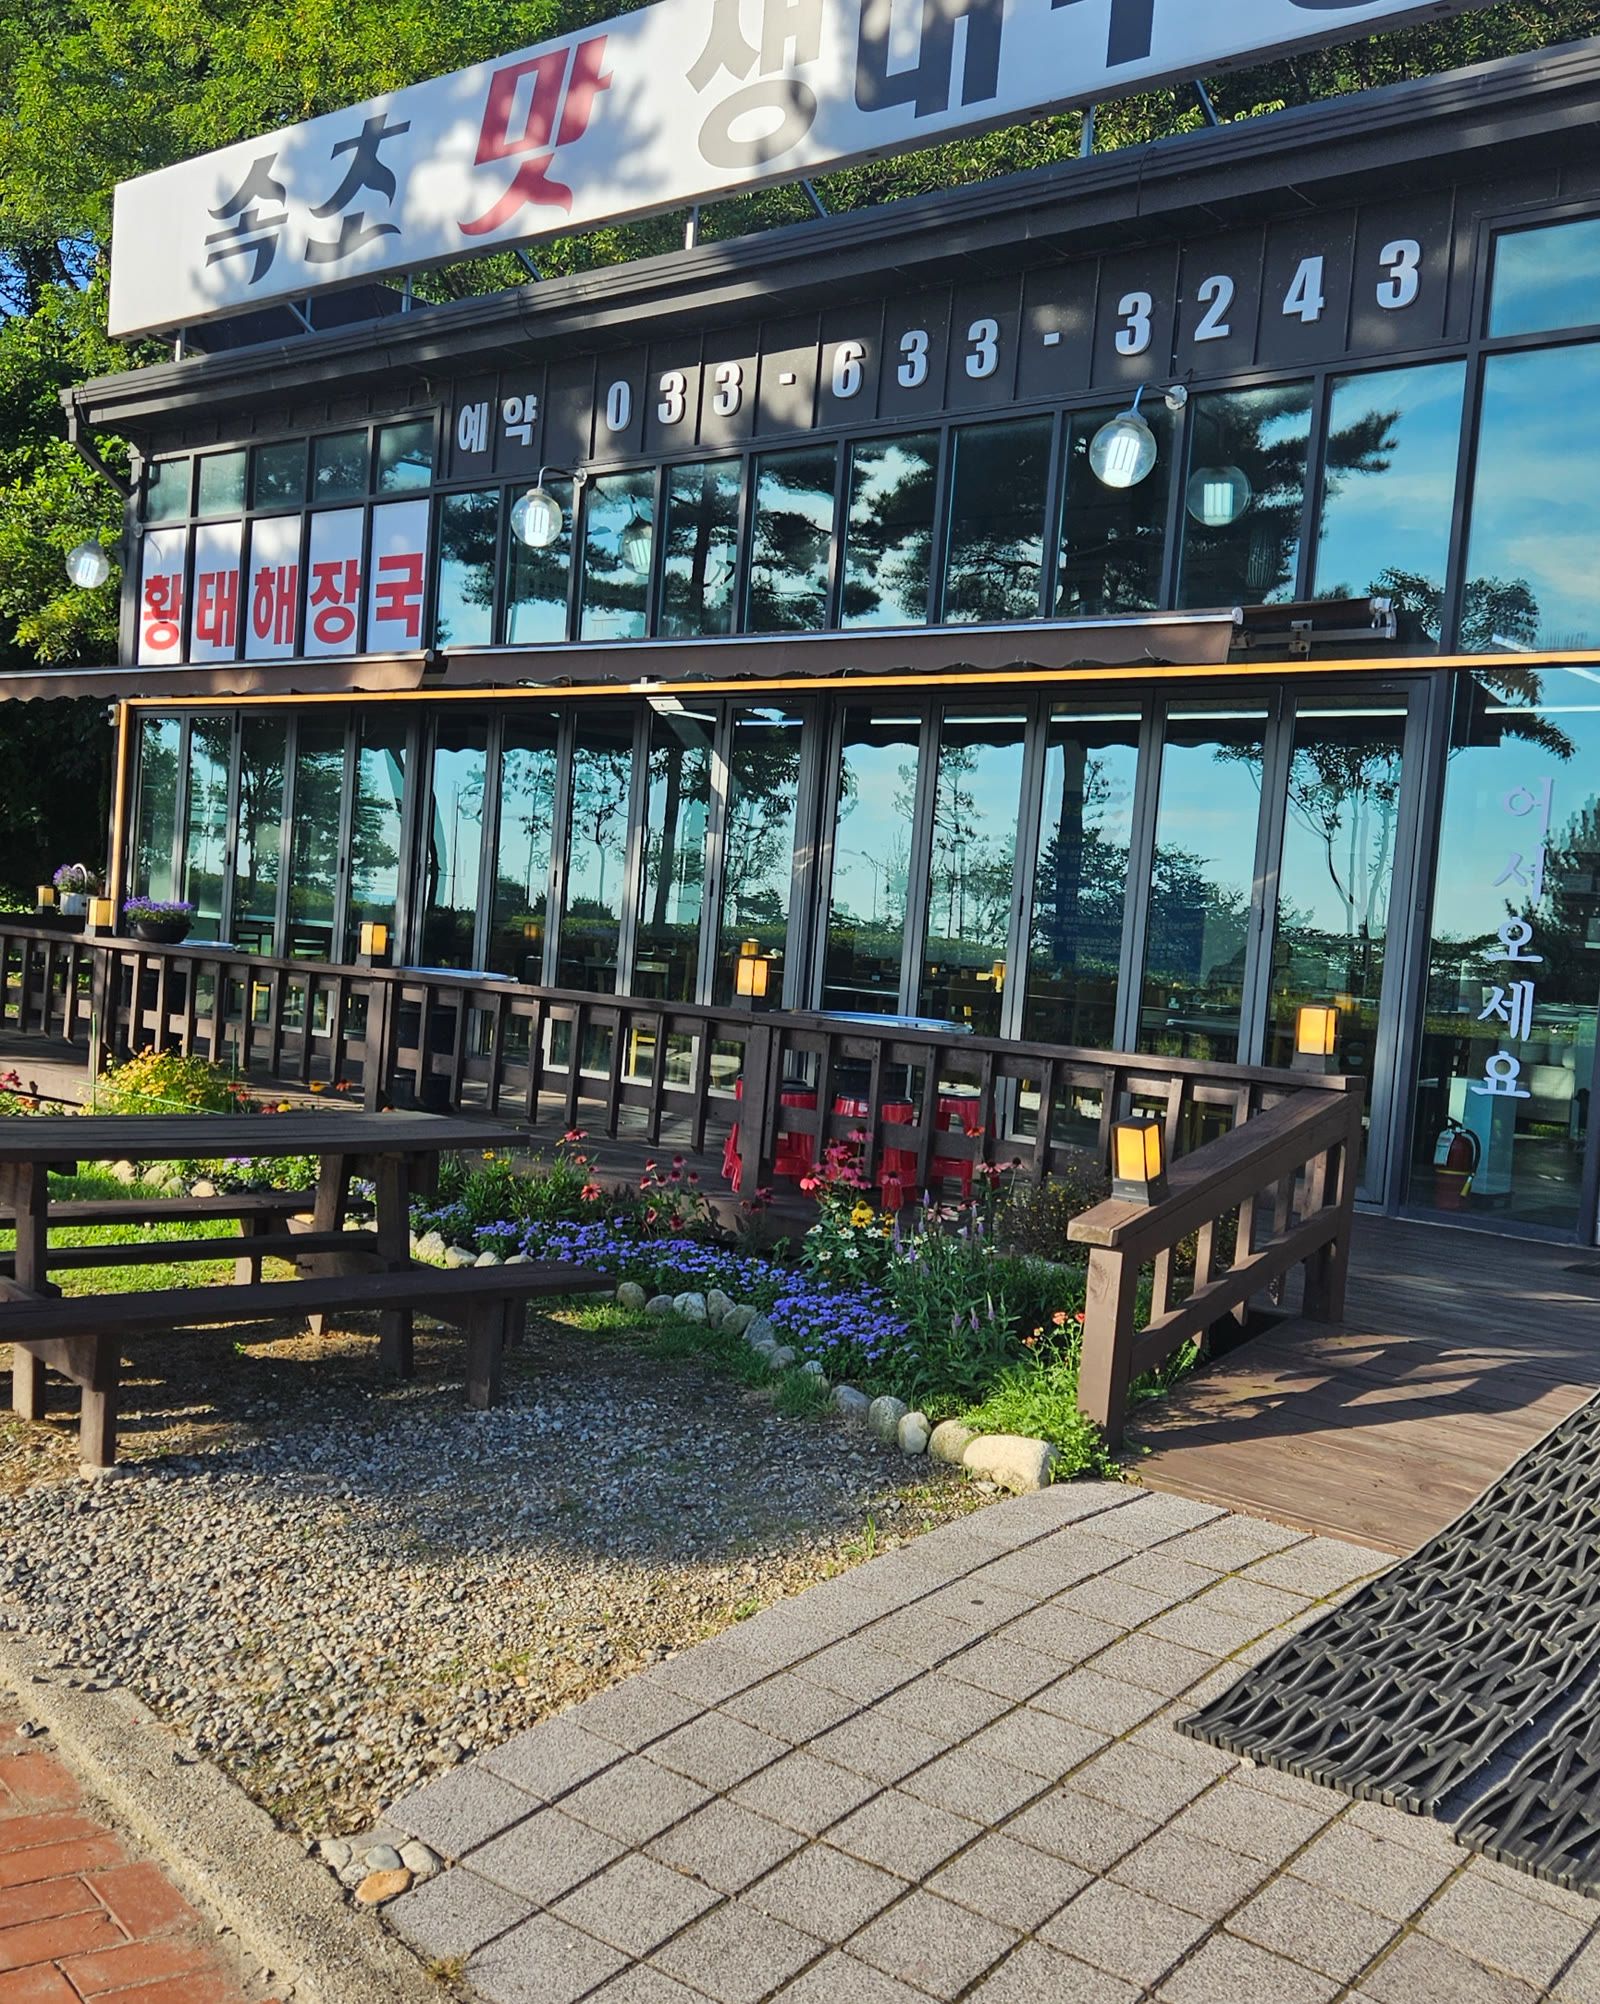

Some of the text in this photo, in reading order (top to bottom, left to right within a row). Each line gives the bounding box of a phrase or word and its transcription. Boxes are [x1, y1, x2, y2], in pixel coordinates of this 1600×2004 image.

[205, 113, 411, 285] 속초
[457, 35, 614, 236] 맛
[458, 239, 1421, 453] 예약 033-633-3243
[143, 553, 423, 651] 황태해장국
[1470, 777, 1554, 1099] 어서오세요
